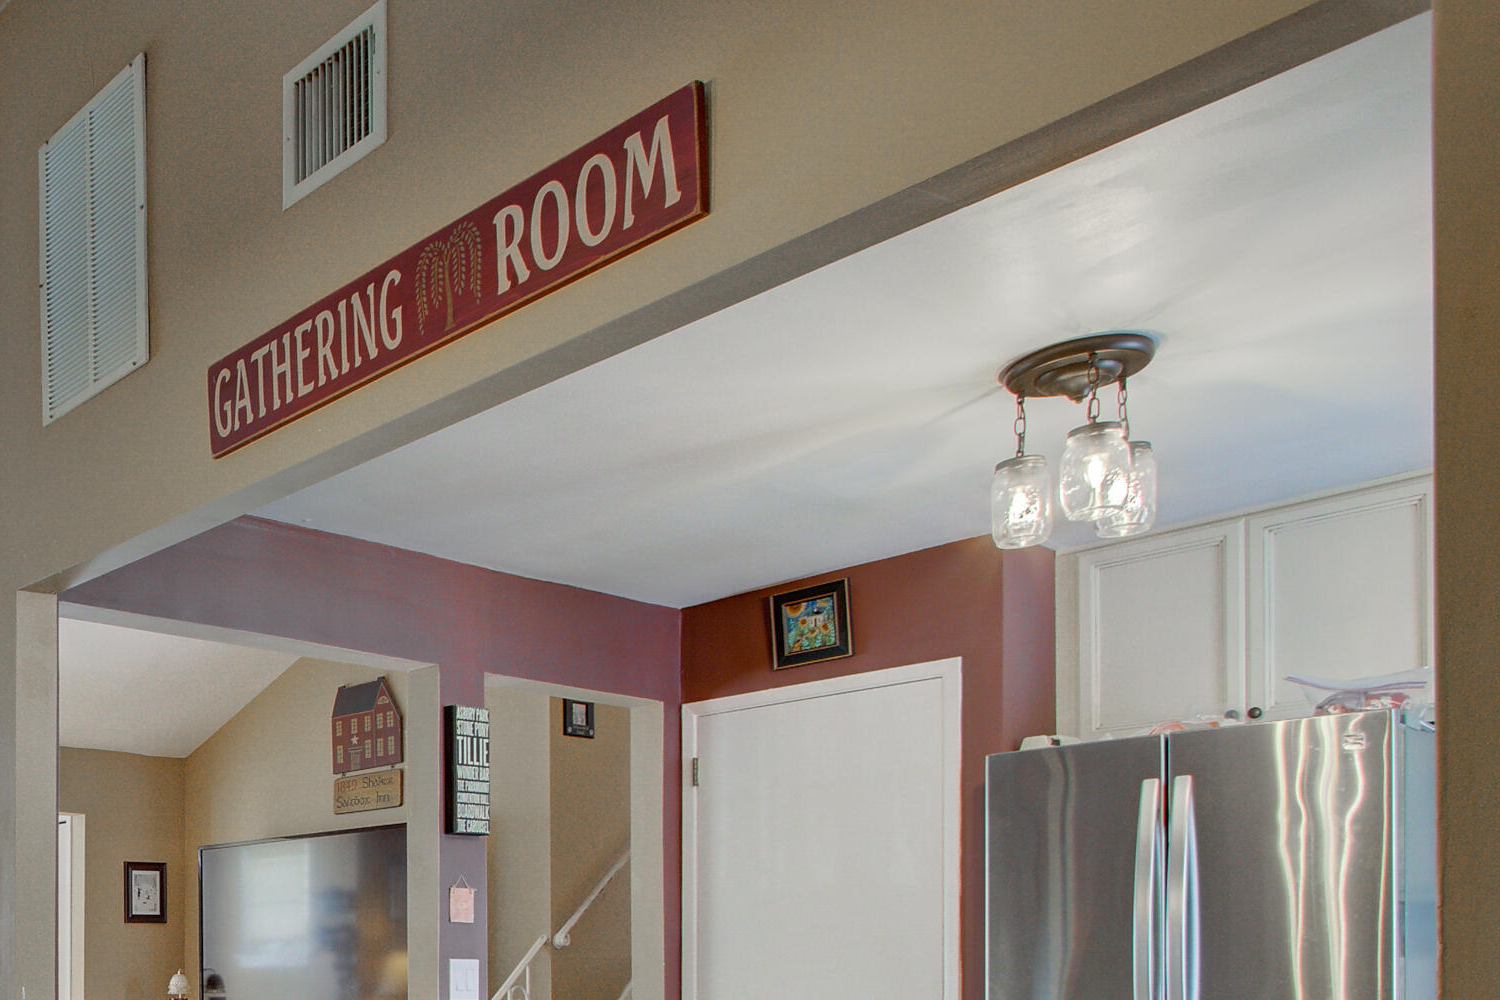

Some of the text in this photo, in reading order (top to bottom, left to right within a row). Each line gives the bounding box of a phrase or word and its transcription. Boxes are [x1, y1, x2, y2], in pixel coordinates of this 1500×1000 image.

[213, 115, 682, 438] GATHERING ROOM
[456, 736, 489, 766] TILLIE
[376, 791, 390, 804] Inn
